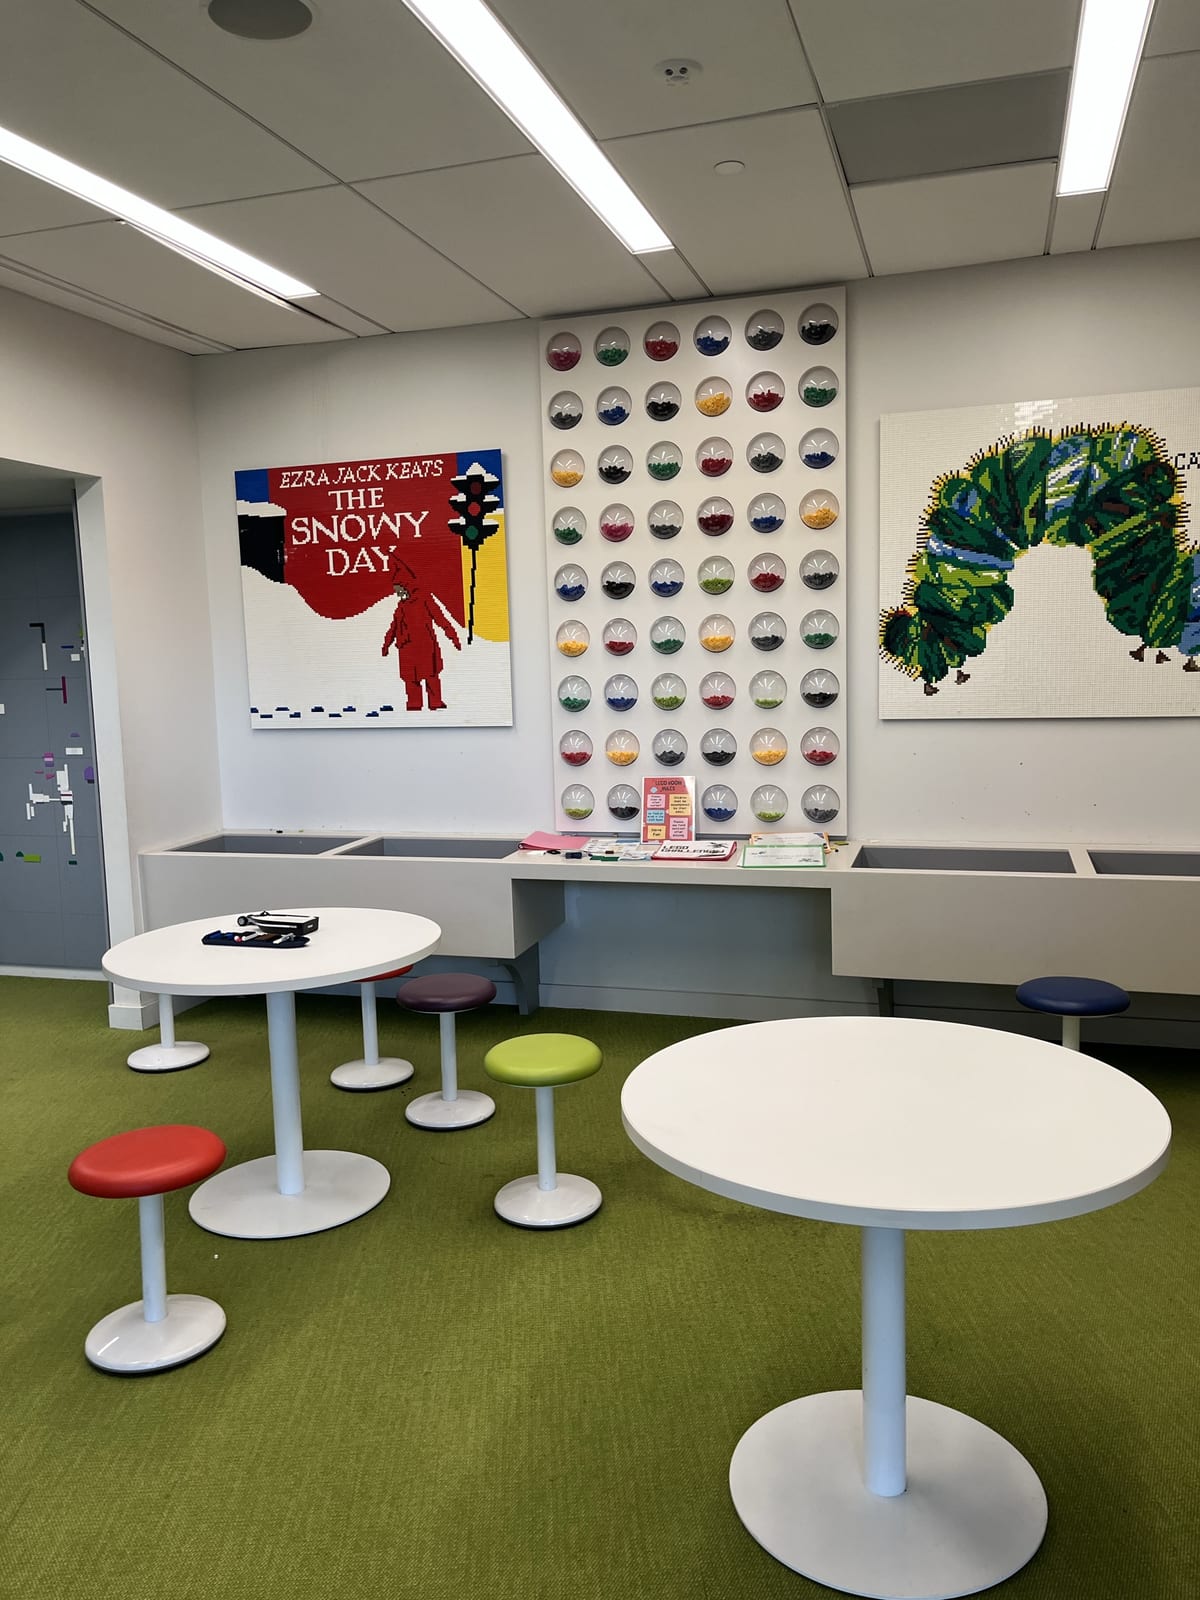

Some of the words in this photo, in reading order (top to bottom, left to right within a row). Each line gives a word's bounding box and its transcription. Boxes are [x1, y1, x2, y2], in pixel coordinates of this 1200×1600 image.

[279, 469, 330, 488] EZRA
[332, 464, 381, 484] JACK
[385, 459, 443, 480] KEATS
[1175, 452, 1200, 470] CA
[328, 487, 385, 510] THE
[291, 511, 429, 545] SNOWY
[325, 545, 397, 576] DAY
